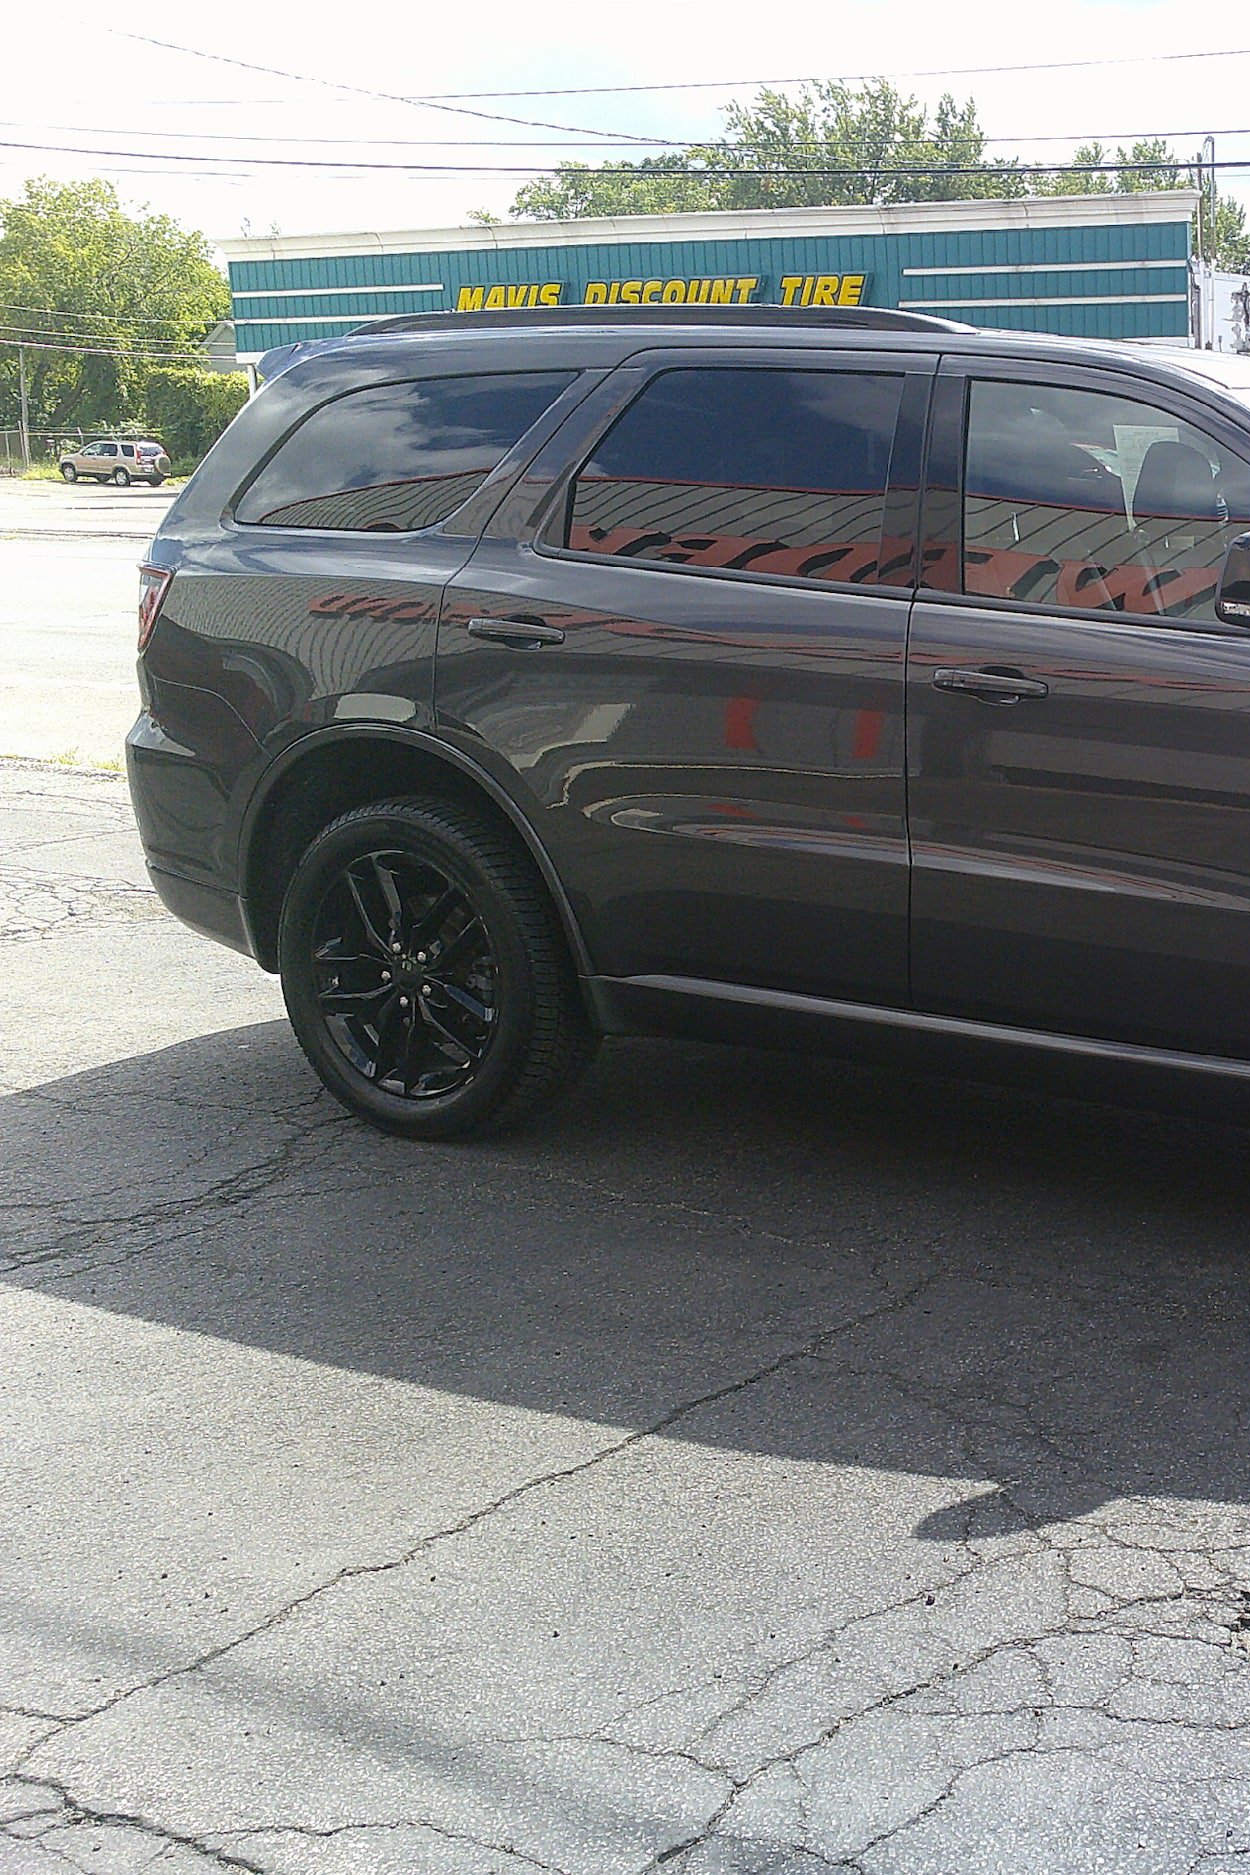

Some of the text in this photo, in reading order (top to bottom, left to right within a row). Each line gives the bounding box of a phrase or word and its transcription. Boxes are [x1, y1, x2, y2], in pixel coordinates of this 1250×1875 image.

[457, 275, 865, 312] MAVIS DISCOUNT TIRE
